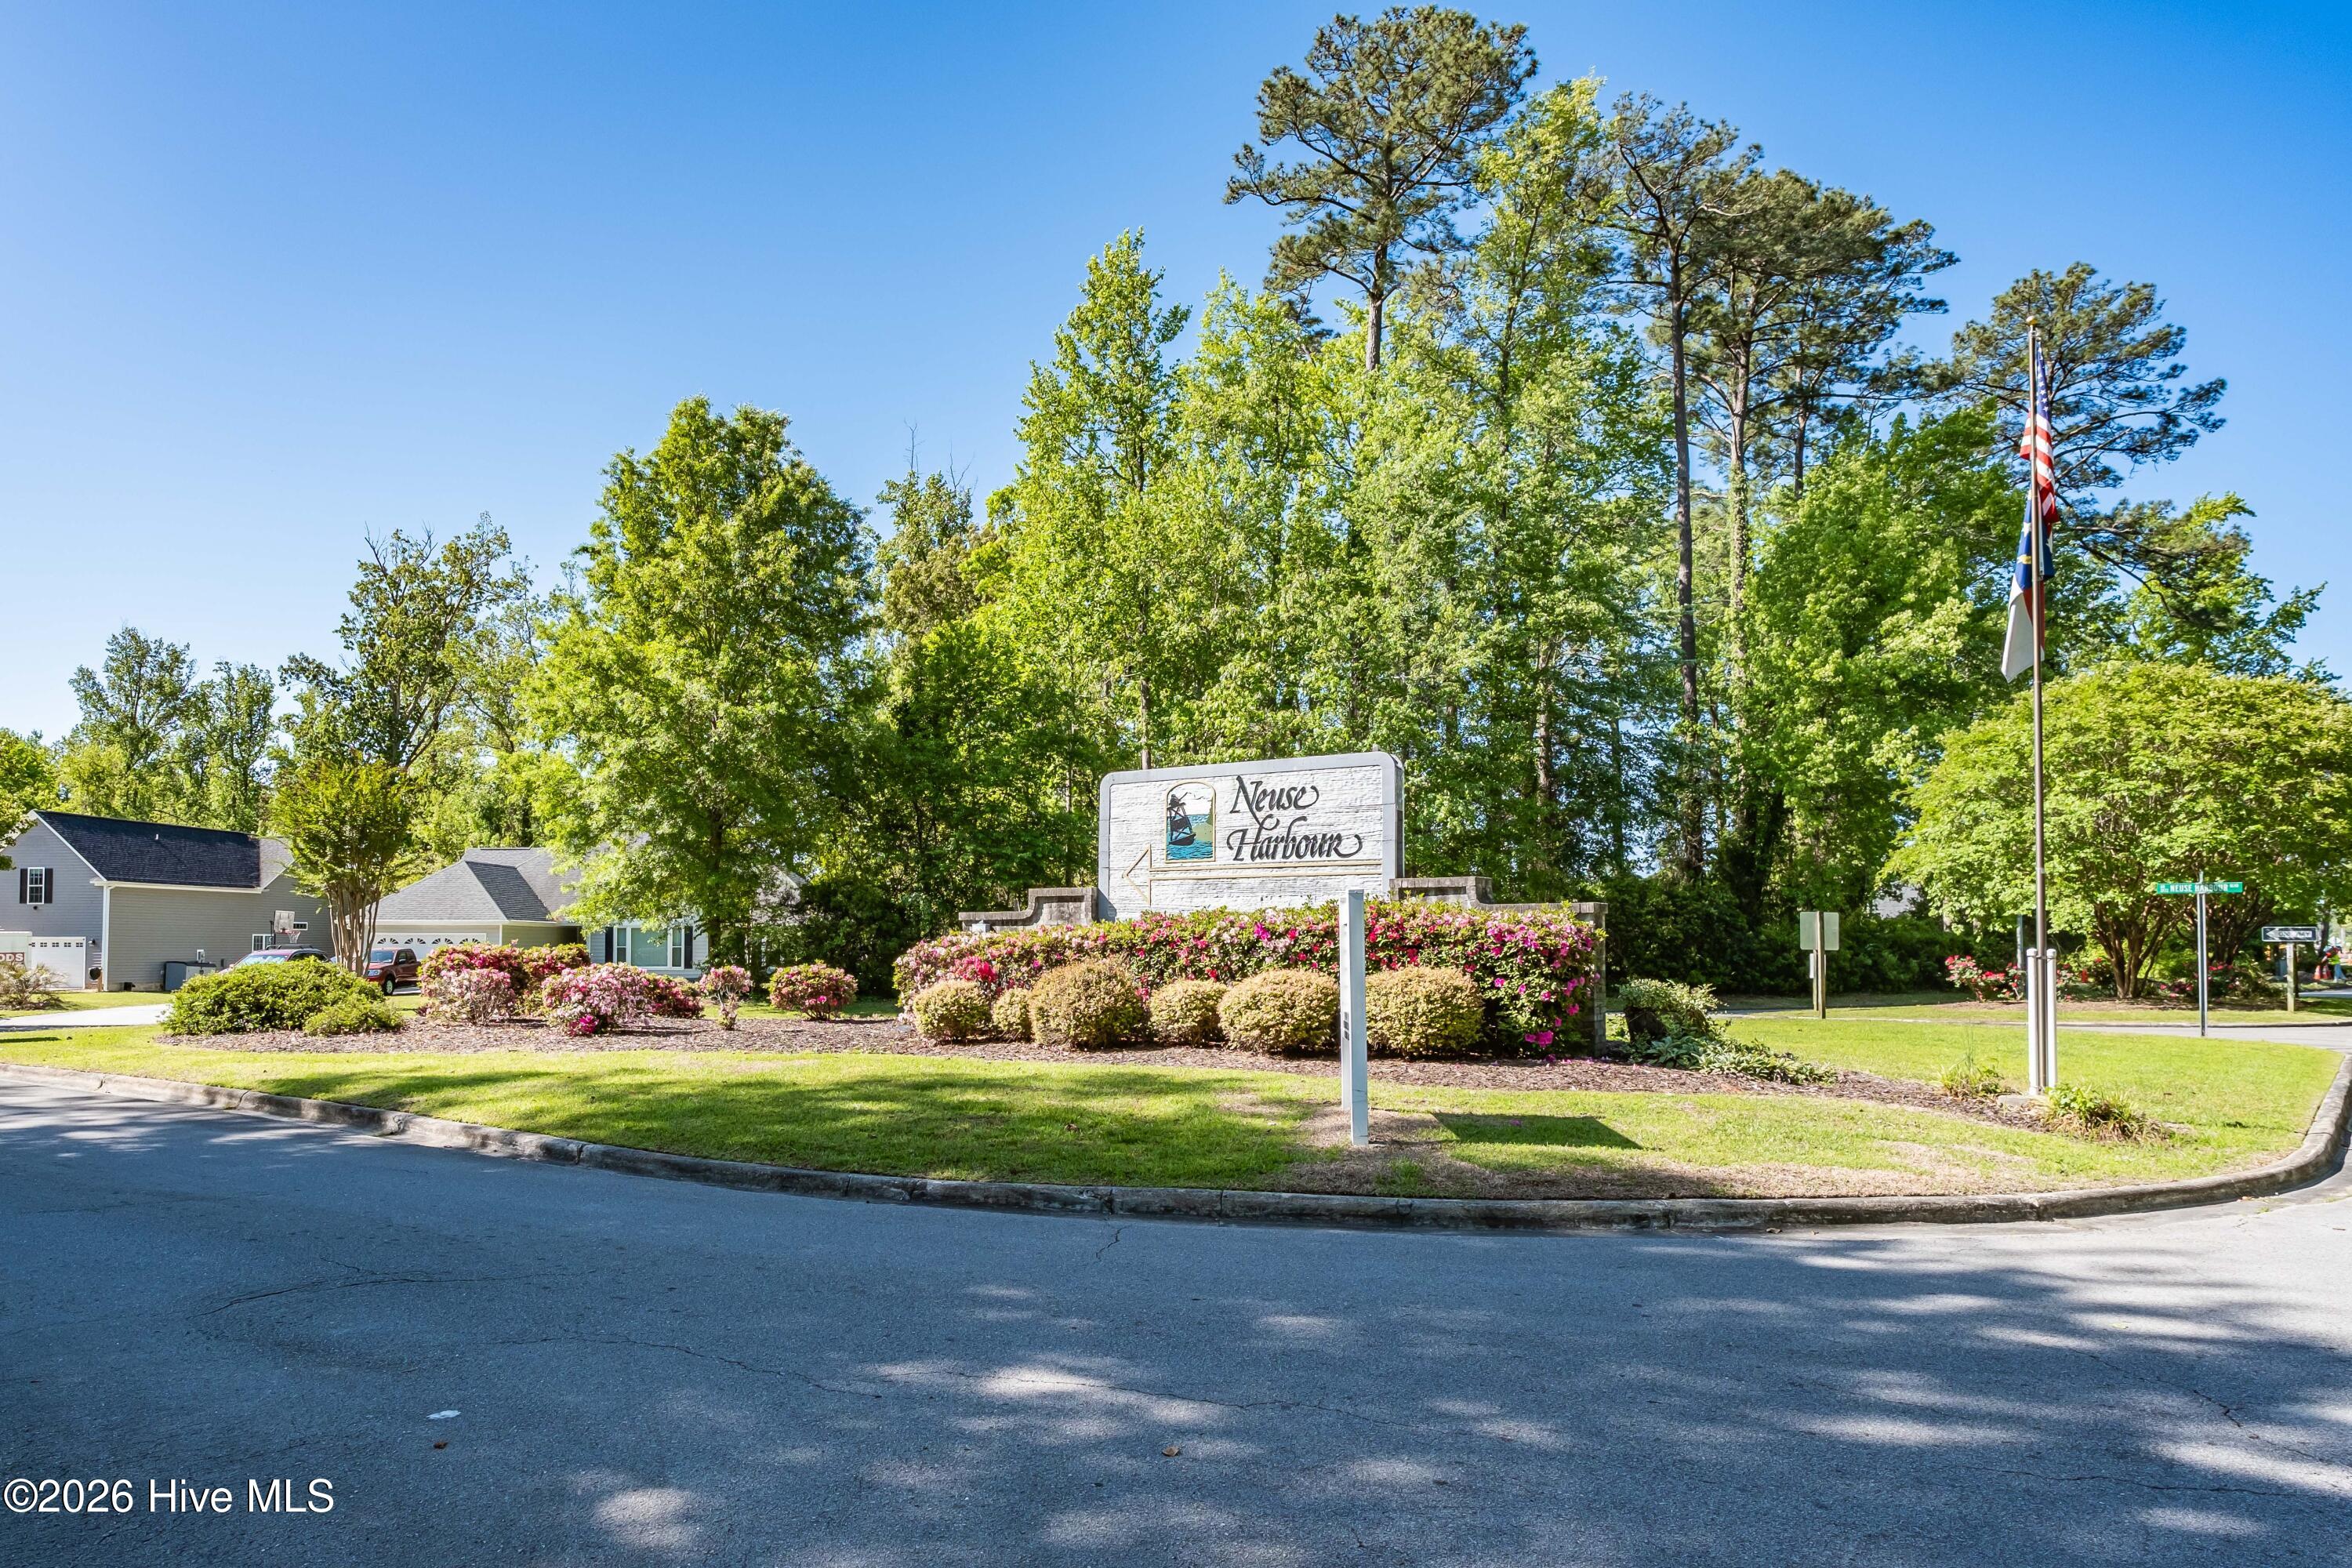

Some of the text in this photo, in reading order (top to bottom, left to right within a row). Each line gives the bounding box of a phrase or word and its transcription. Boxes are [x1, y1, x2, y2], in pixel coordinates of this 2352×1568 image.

[1229, 775, 1319, 830] Neuse
[1226, 816, 1363, 862] Harbour
[2194, 884, 2228, 892] HARBOUR
